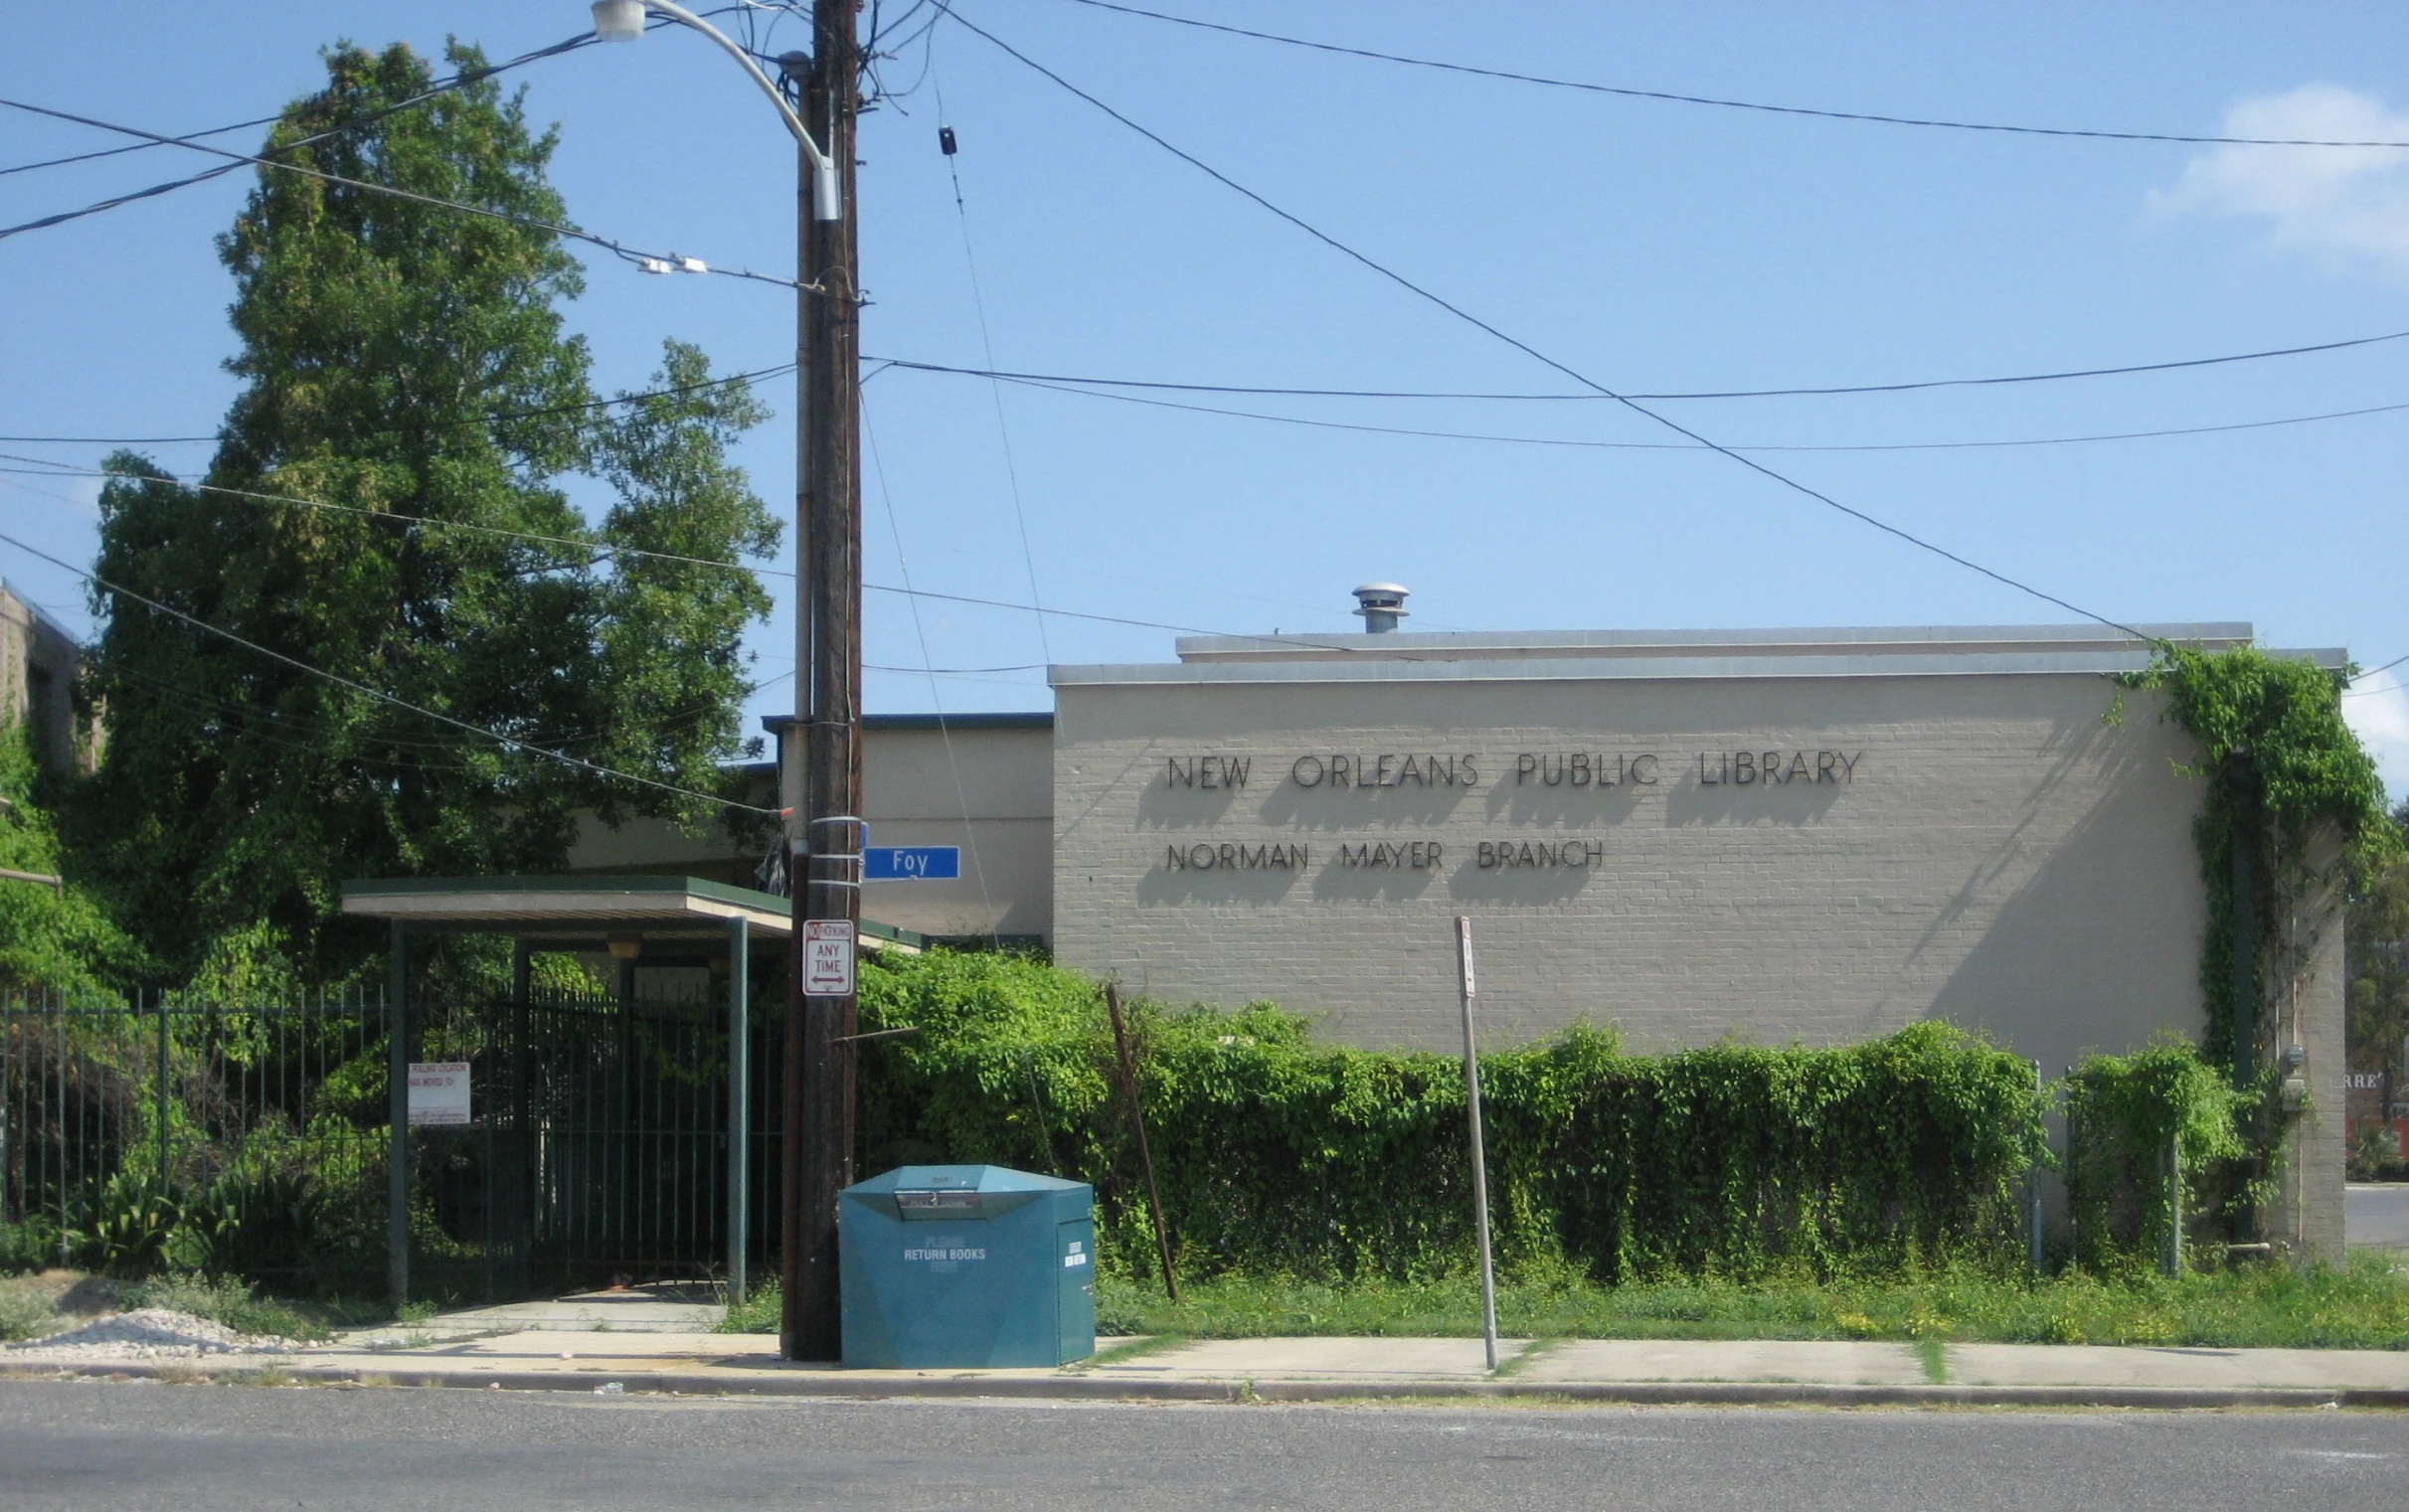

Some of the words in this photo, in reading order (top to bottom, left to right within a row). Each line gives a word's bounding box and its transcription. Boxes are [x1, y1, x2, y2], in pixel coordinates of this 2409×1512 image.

[1168, 756, 1252, 788] NEW
[1292, 755, 1478, 787] ORLEANS
[1518, 754, 1659, 785] PUBLIC
[1700, 752, 1862, 784] LIBRARY
[893, 850, 929, 875] Foy
[1167, 844, 1308, 870] NORMAN
[1342, 842, 1443, 869] MAYER
[1478, 841, 1603, 868] BRANCH
[806, 924, 818, 938] NO
[820, 925, 851, 936] PARKING
[817, 944, 840, 956] ANY
[815, 960, 841, 973] TIME
[904, 1249, 946, 1260] RETURN
[949, 1249, 985, 1260] BOOKS
